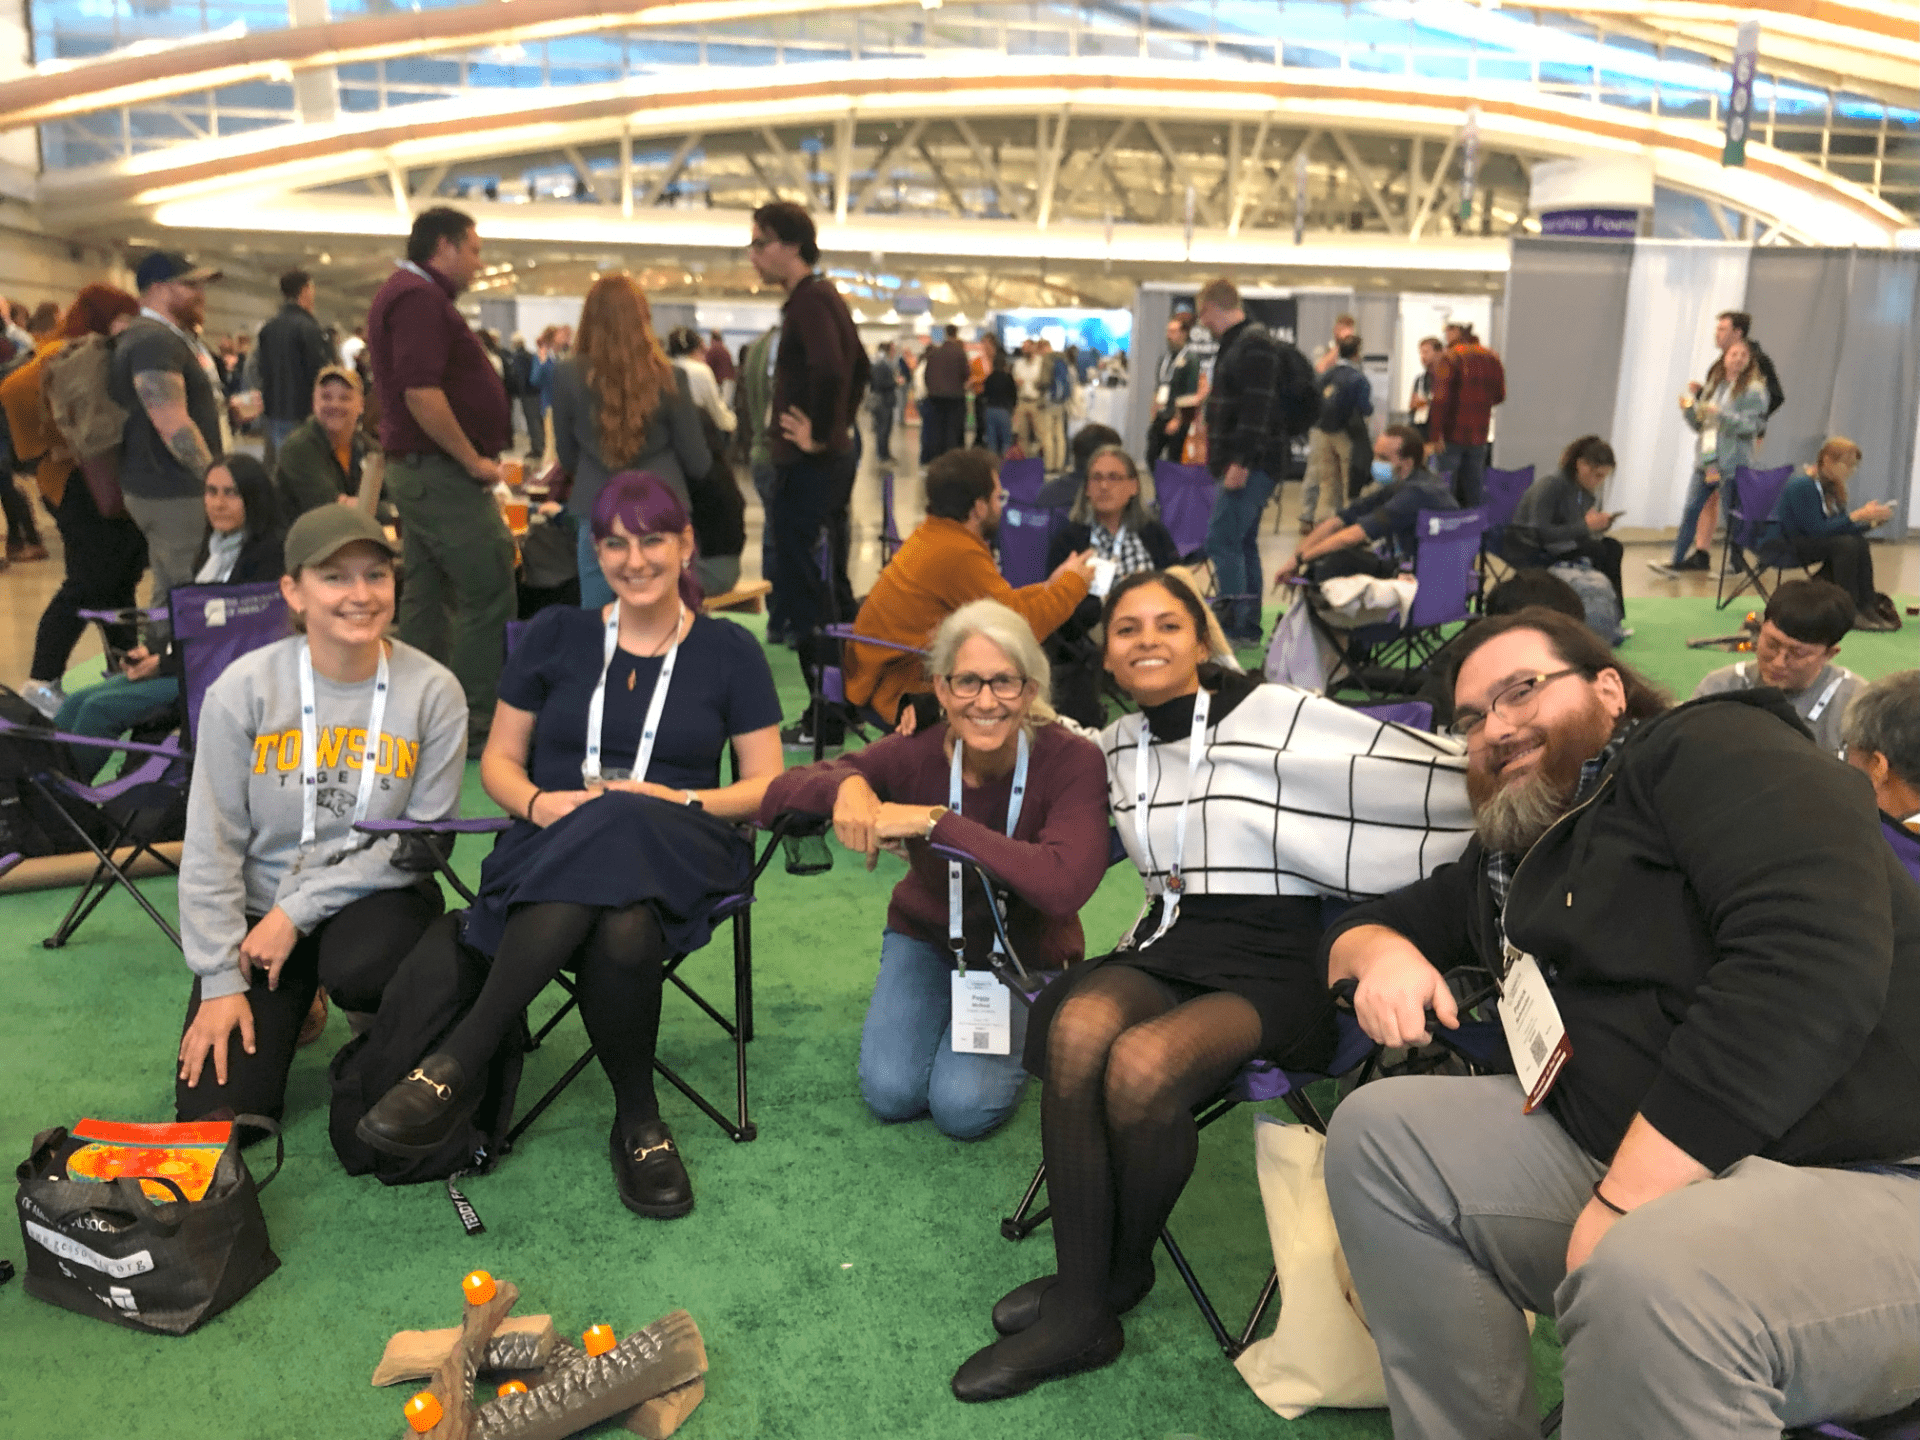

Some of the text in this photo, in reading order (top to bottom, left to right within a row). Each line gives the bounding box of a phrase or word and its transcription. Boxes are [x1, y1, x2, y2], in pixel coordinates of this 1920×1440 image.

[253, 727, 419, 778] TOWSON
[278, 770, 391, 791] TIGES
[454, 1200, 480, 1230] TEDDY
